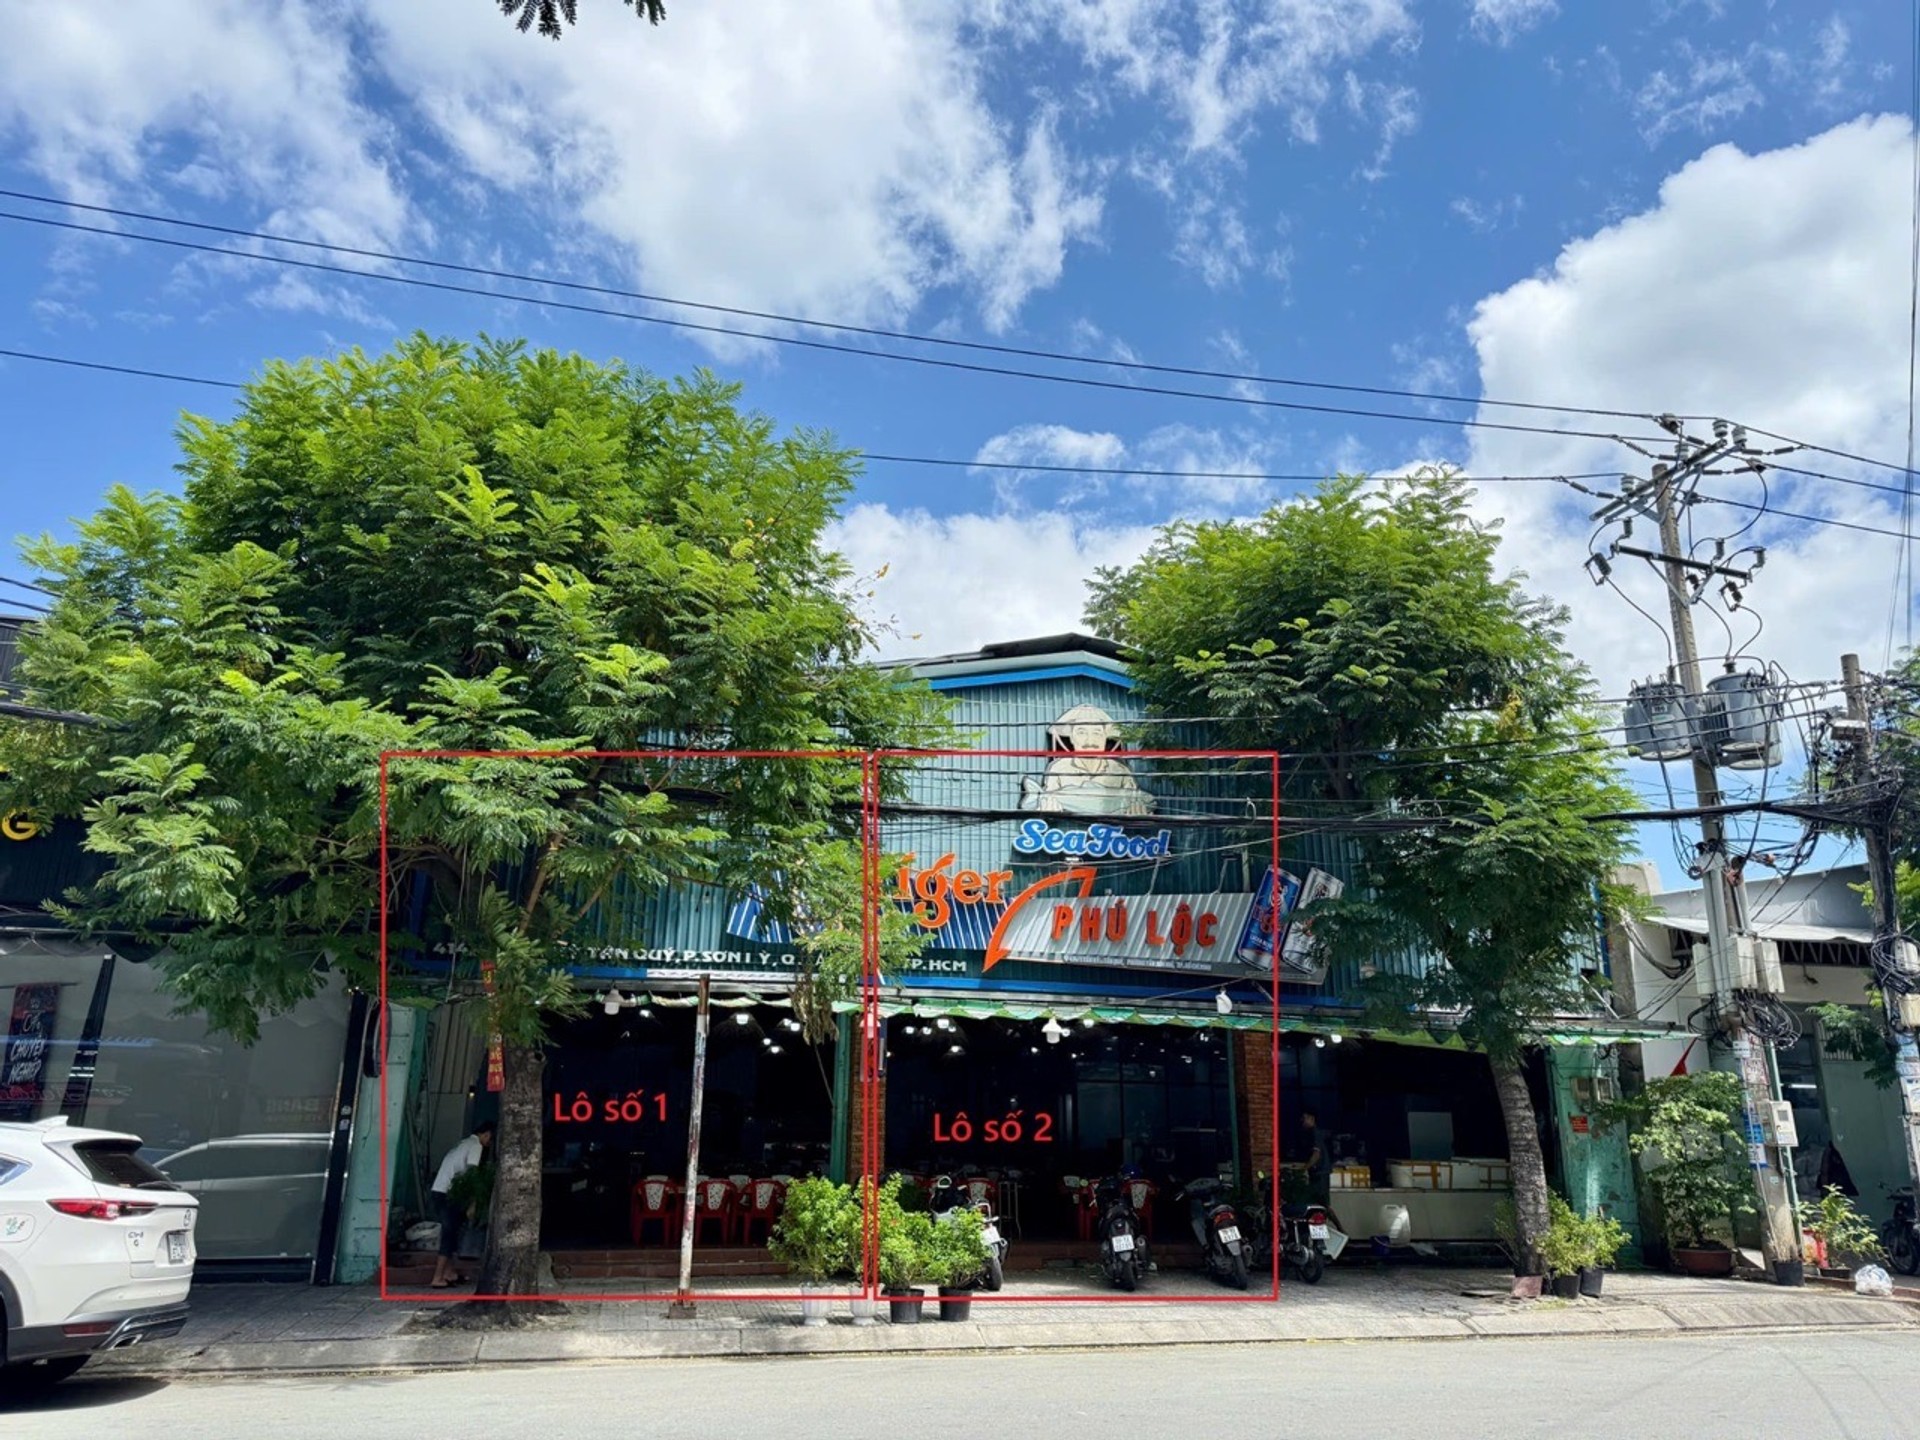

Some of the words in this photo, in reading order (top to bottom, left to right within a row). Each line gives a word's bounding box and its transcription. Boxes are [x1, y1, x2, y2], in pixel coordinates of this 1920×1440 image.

[1013, 818, 1171, 858] SeaFood
[893, 853, 1013, 928] iger
[1051, 899, 1128, 942] PHÚ
[1146, 901, 1218, 956] LỘC
